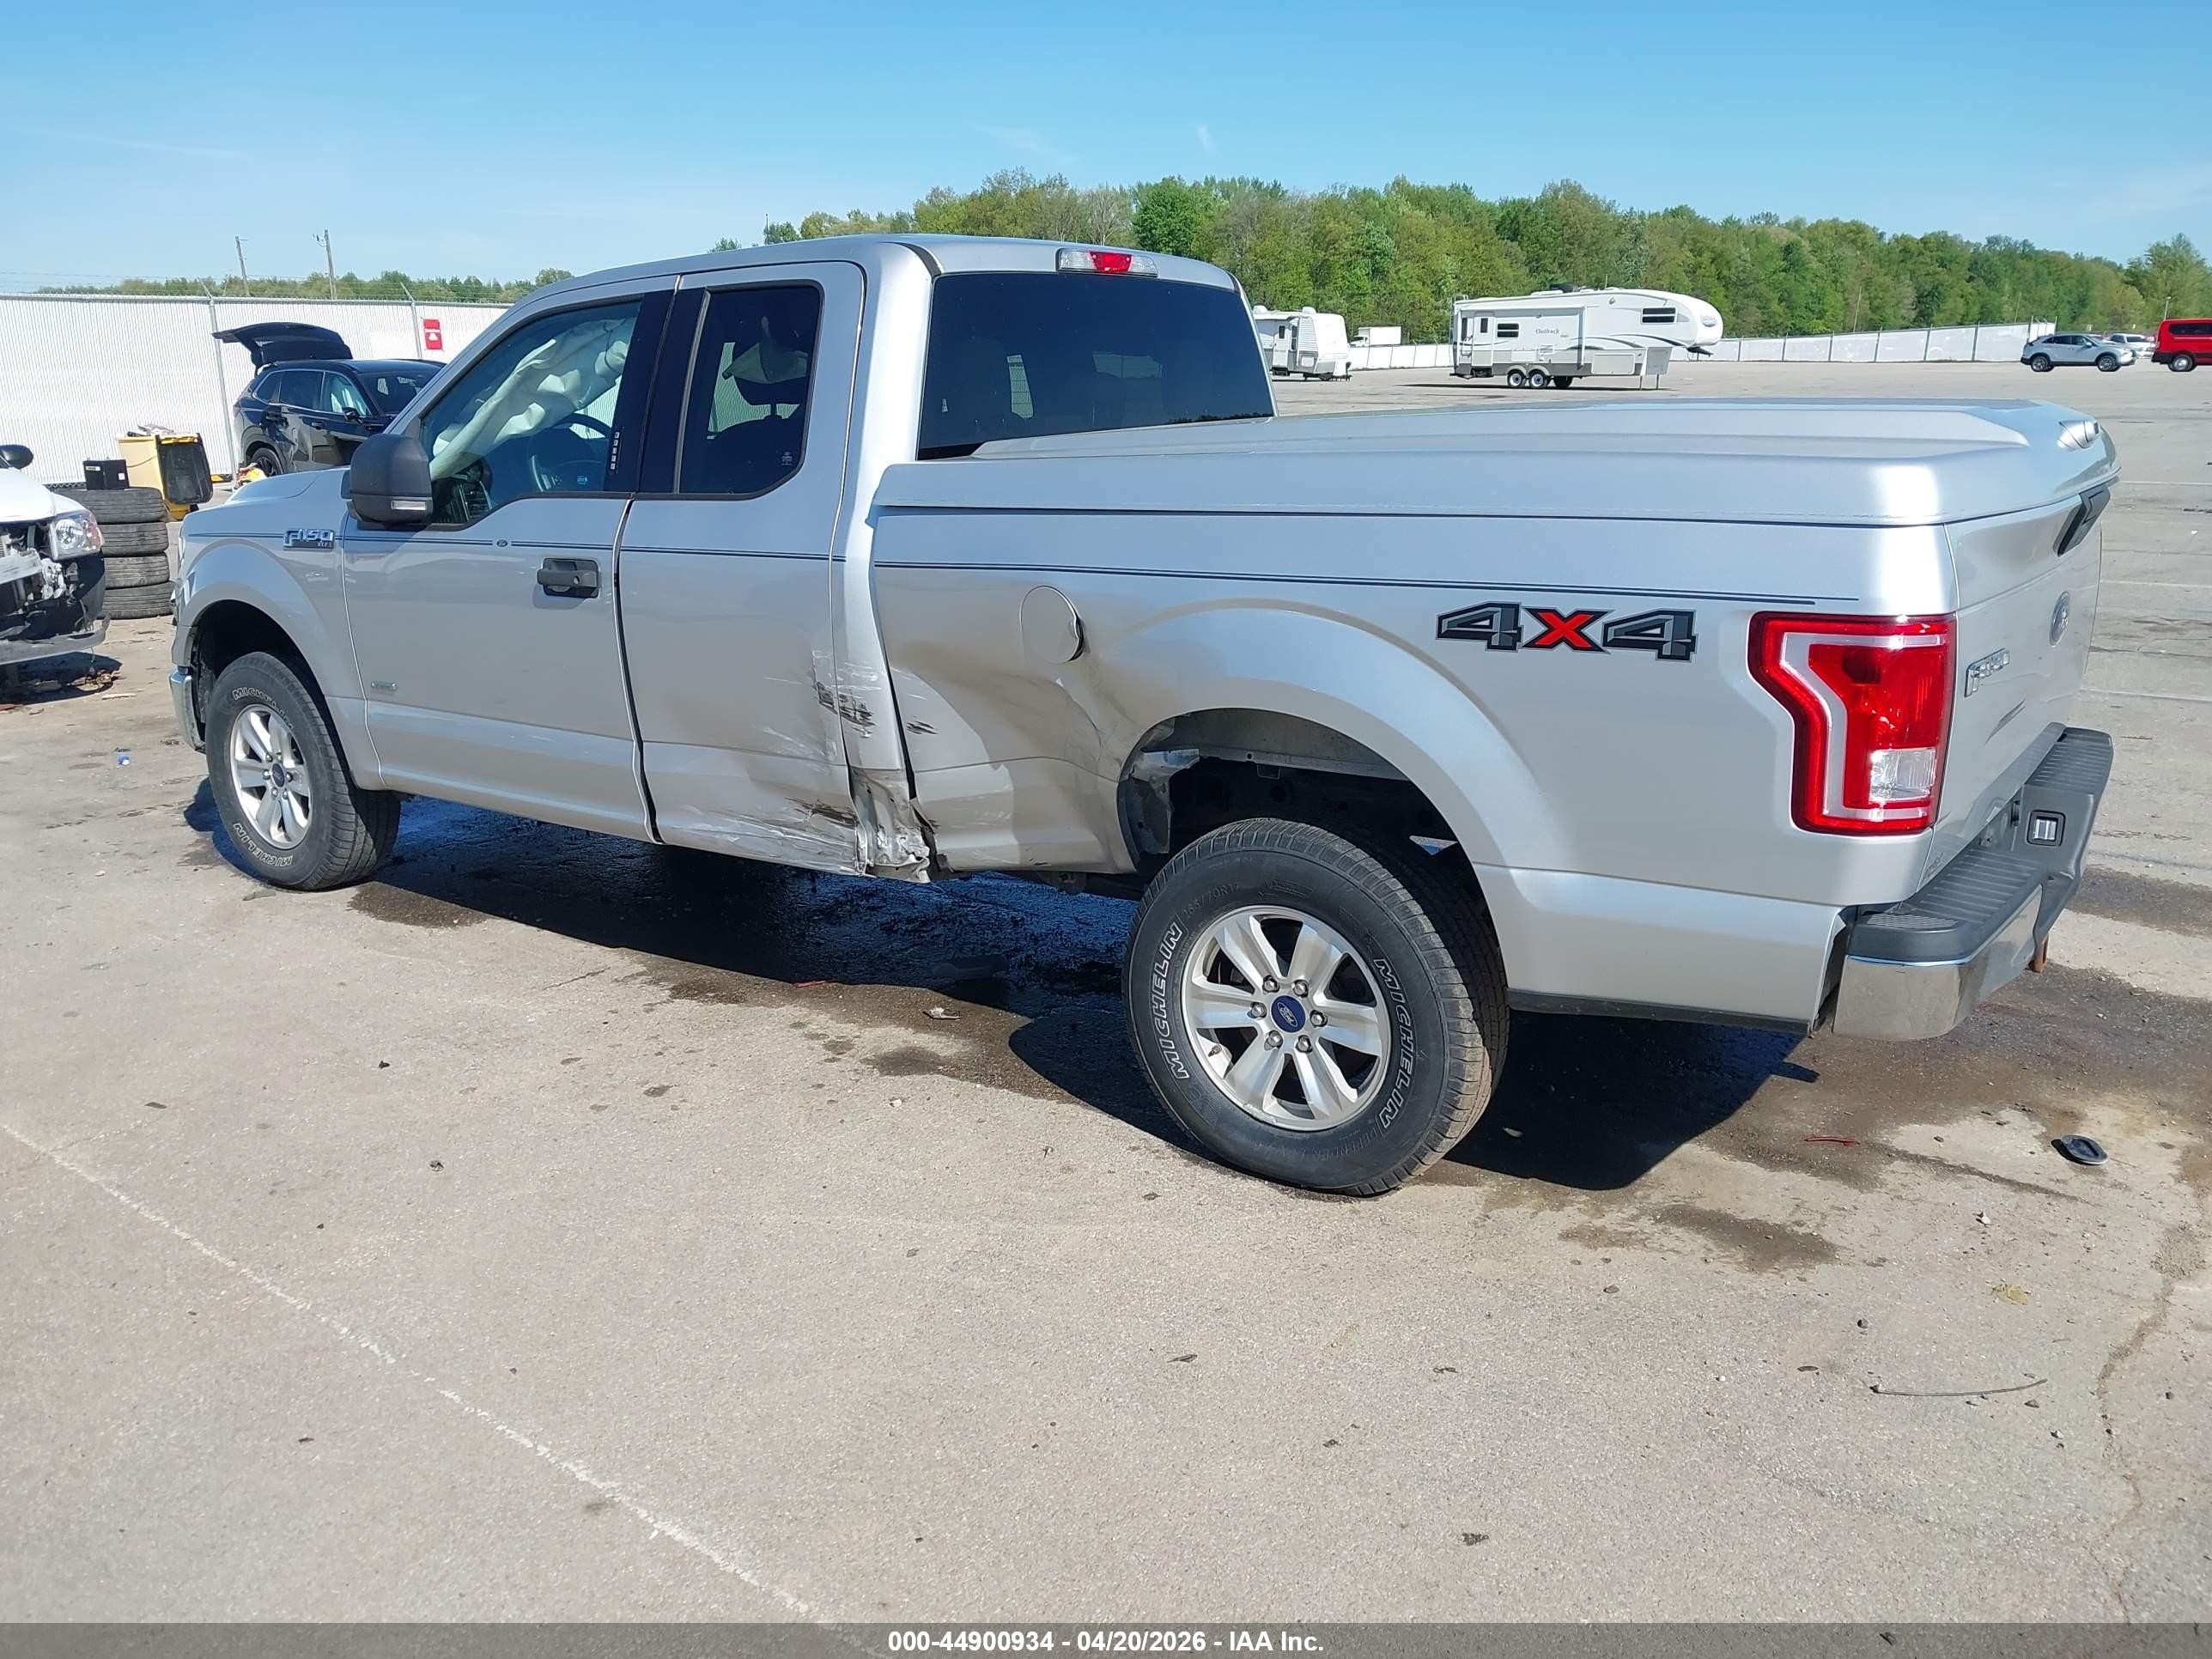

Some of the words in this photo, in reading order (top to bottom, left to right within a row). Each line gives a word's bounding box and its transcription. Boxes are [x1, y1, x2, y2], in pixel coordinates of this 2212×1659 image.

[1435, 601, 1699, 663] 4X4
[232, 687, 295, 729] MICHELIN
[233, 823, 294, 867] MICHELIN
[1150, 922, 1190, 1080] MICHELIN
[1372, 957, 1417, 1129] MICHELIN
